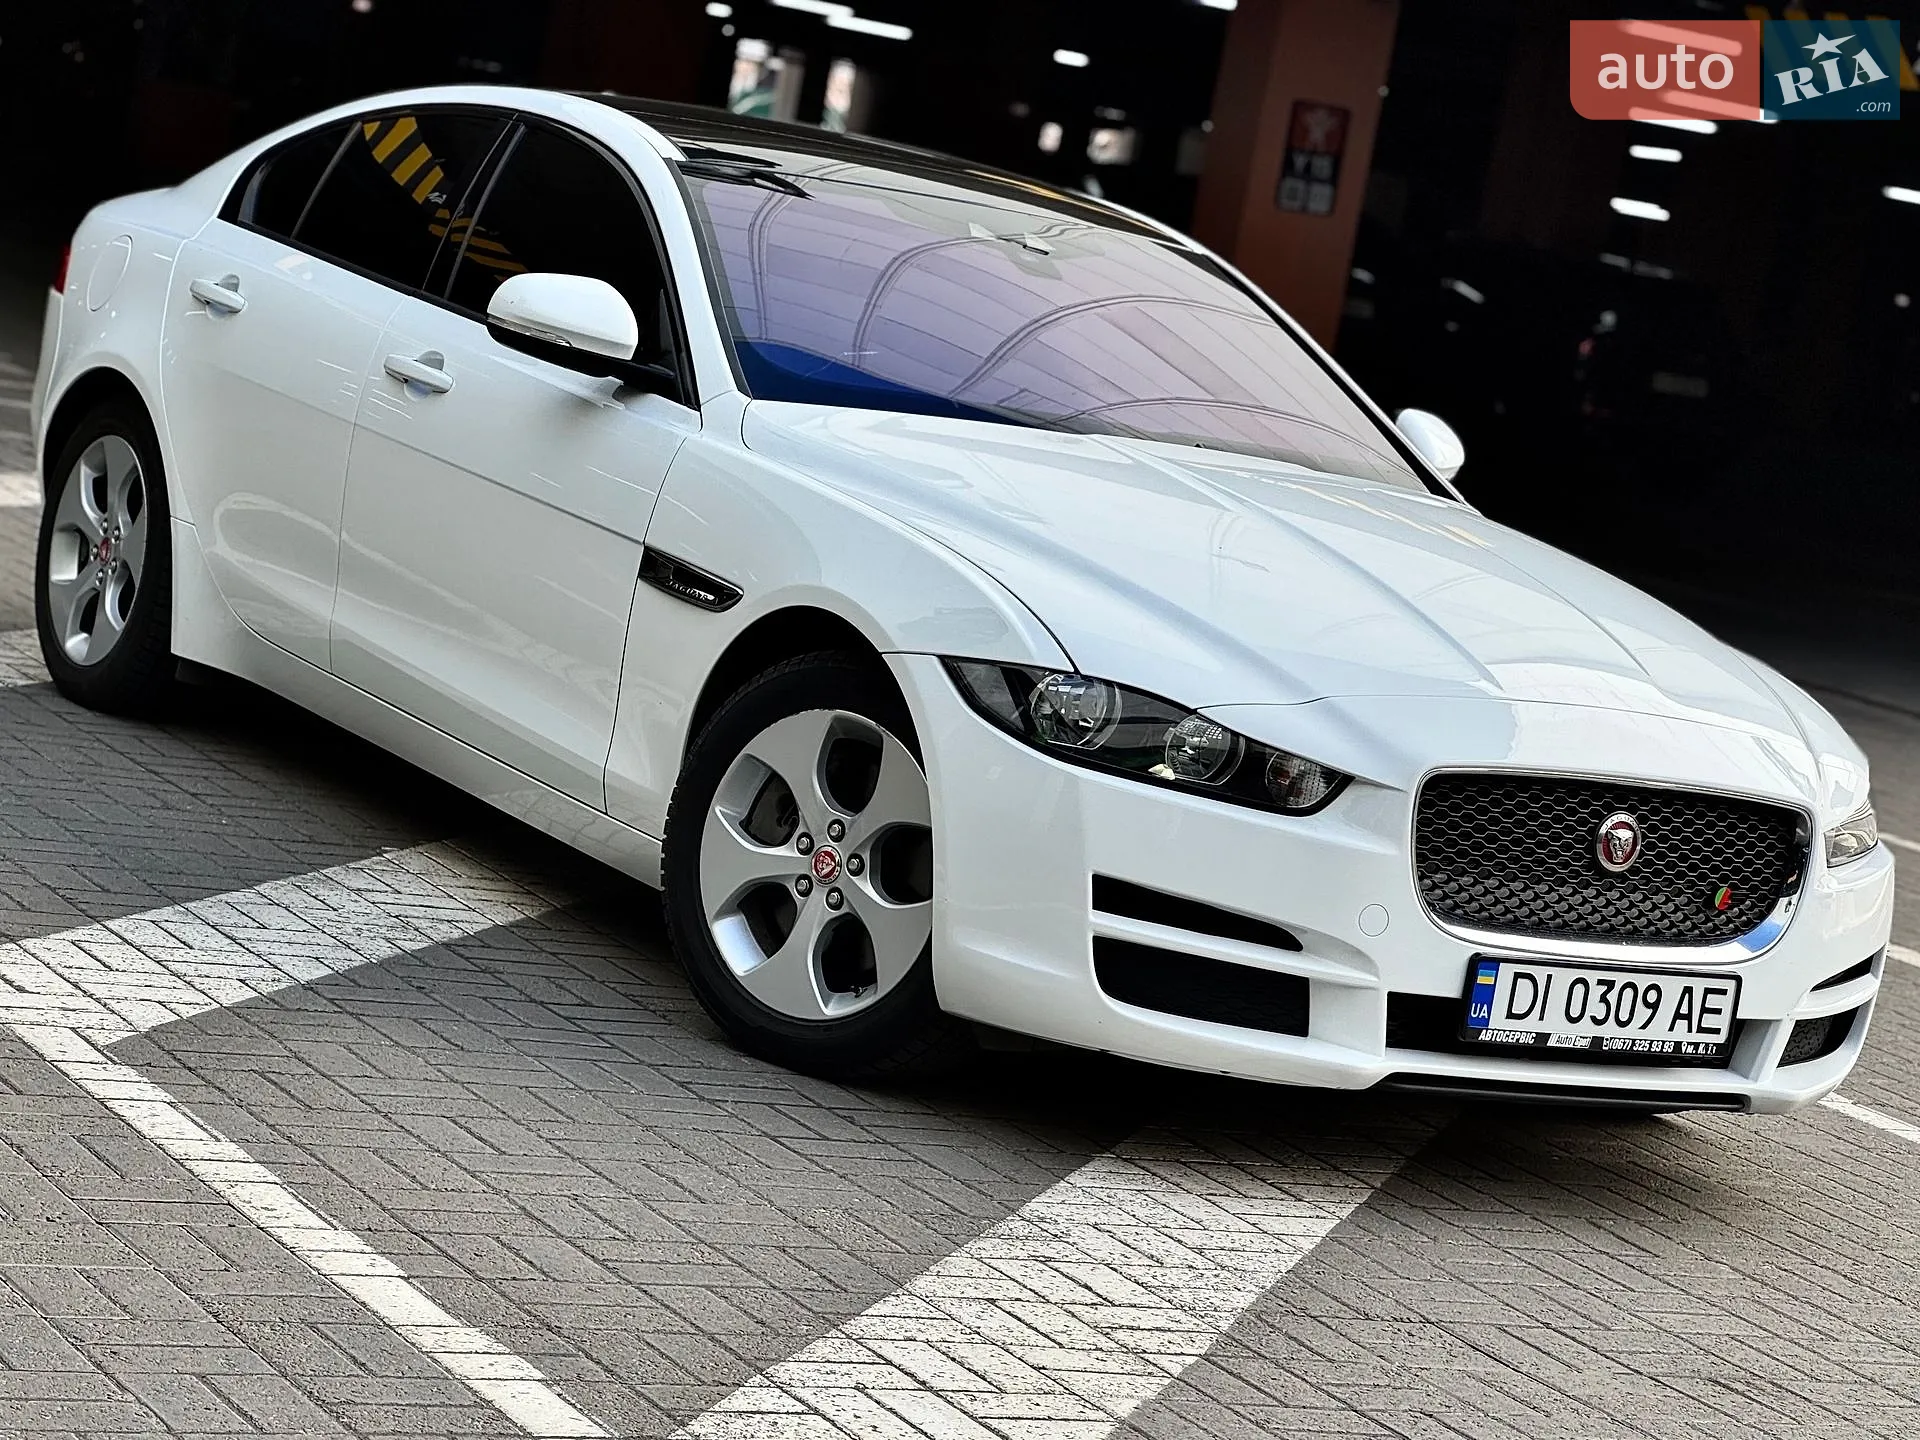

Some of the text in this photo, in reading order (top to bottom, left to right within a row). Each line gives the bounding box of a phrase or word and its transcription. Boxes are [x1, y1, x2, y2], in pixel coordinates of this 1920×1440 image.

[1470, 1002, 1488, 1019] UA
[1505, 971, 1728, 1035] DI 0309 AE
[1478, 1029, 1536, 1045] АВТОСЕРВІС
[1609, 1038, 1675, 1053] (067) 325 93 93
